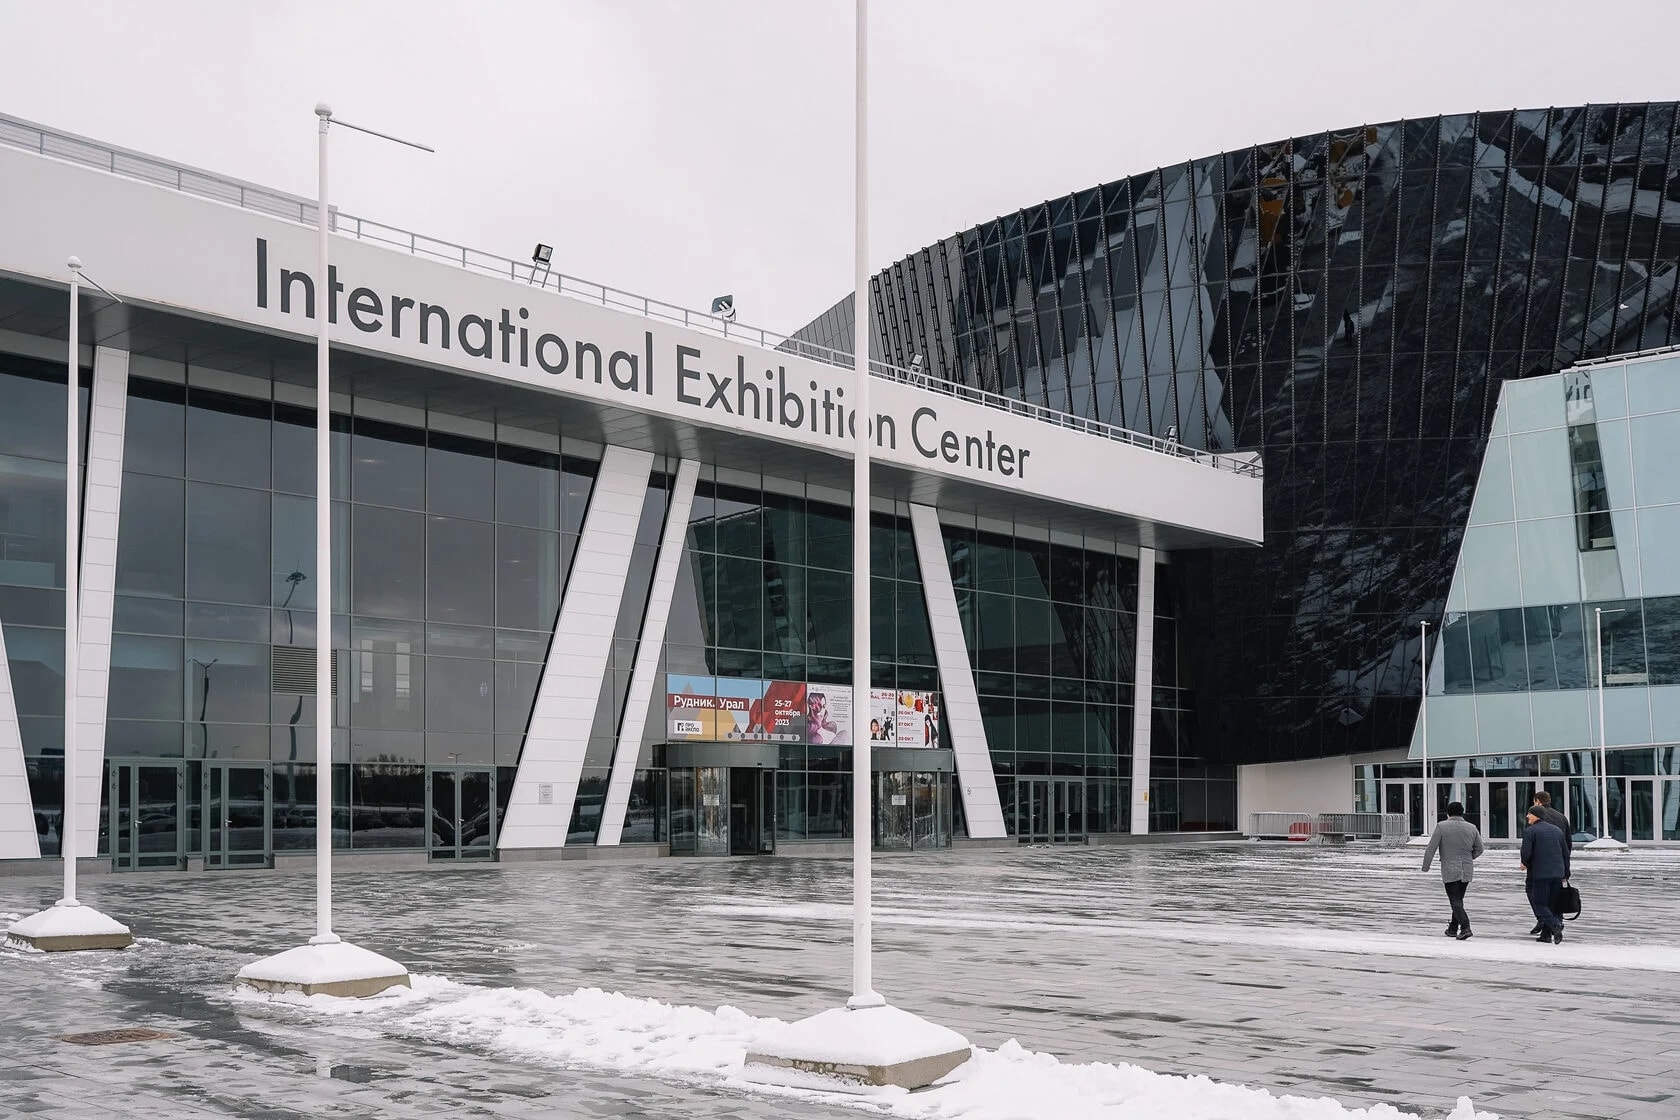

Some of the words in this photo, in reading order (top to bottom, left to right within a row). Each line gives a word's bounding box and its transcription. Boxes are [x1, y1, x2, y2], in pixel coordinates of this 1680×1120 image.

[256, 237, 653, 396] International
[911, 406, 1031, 479] Center
[673, 695, 715, 708] Рудник.
[719, 698, 744, 711] Урал
[774, 700, 792, 708] 25-27
[774, 709, 801, 718] октября
[774, 718, 790, 726] 2023
